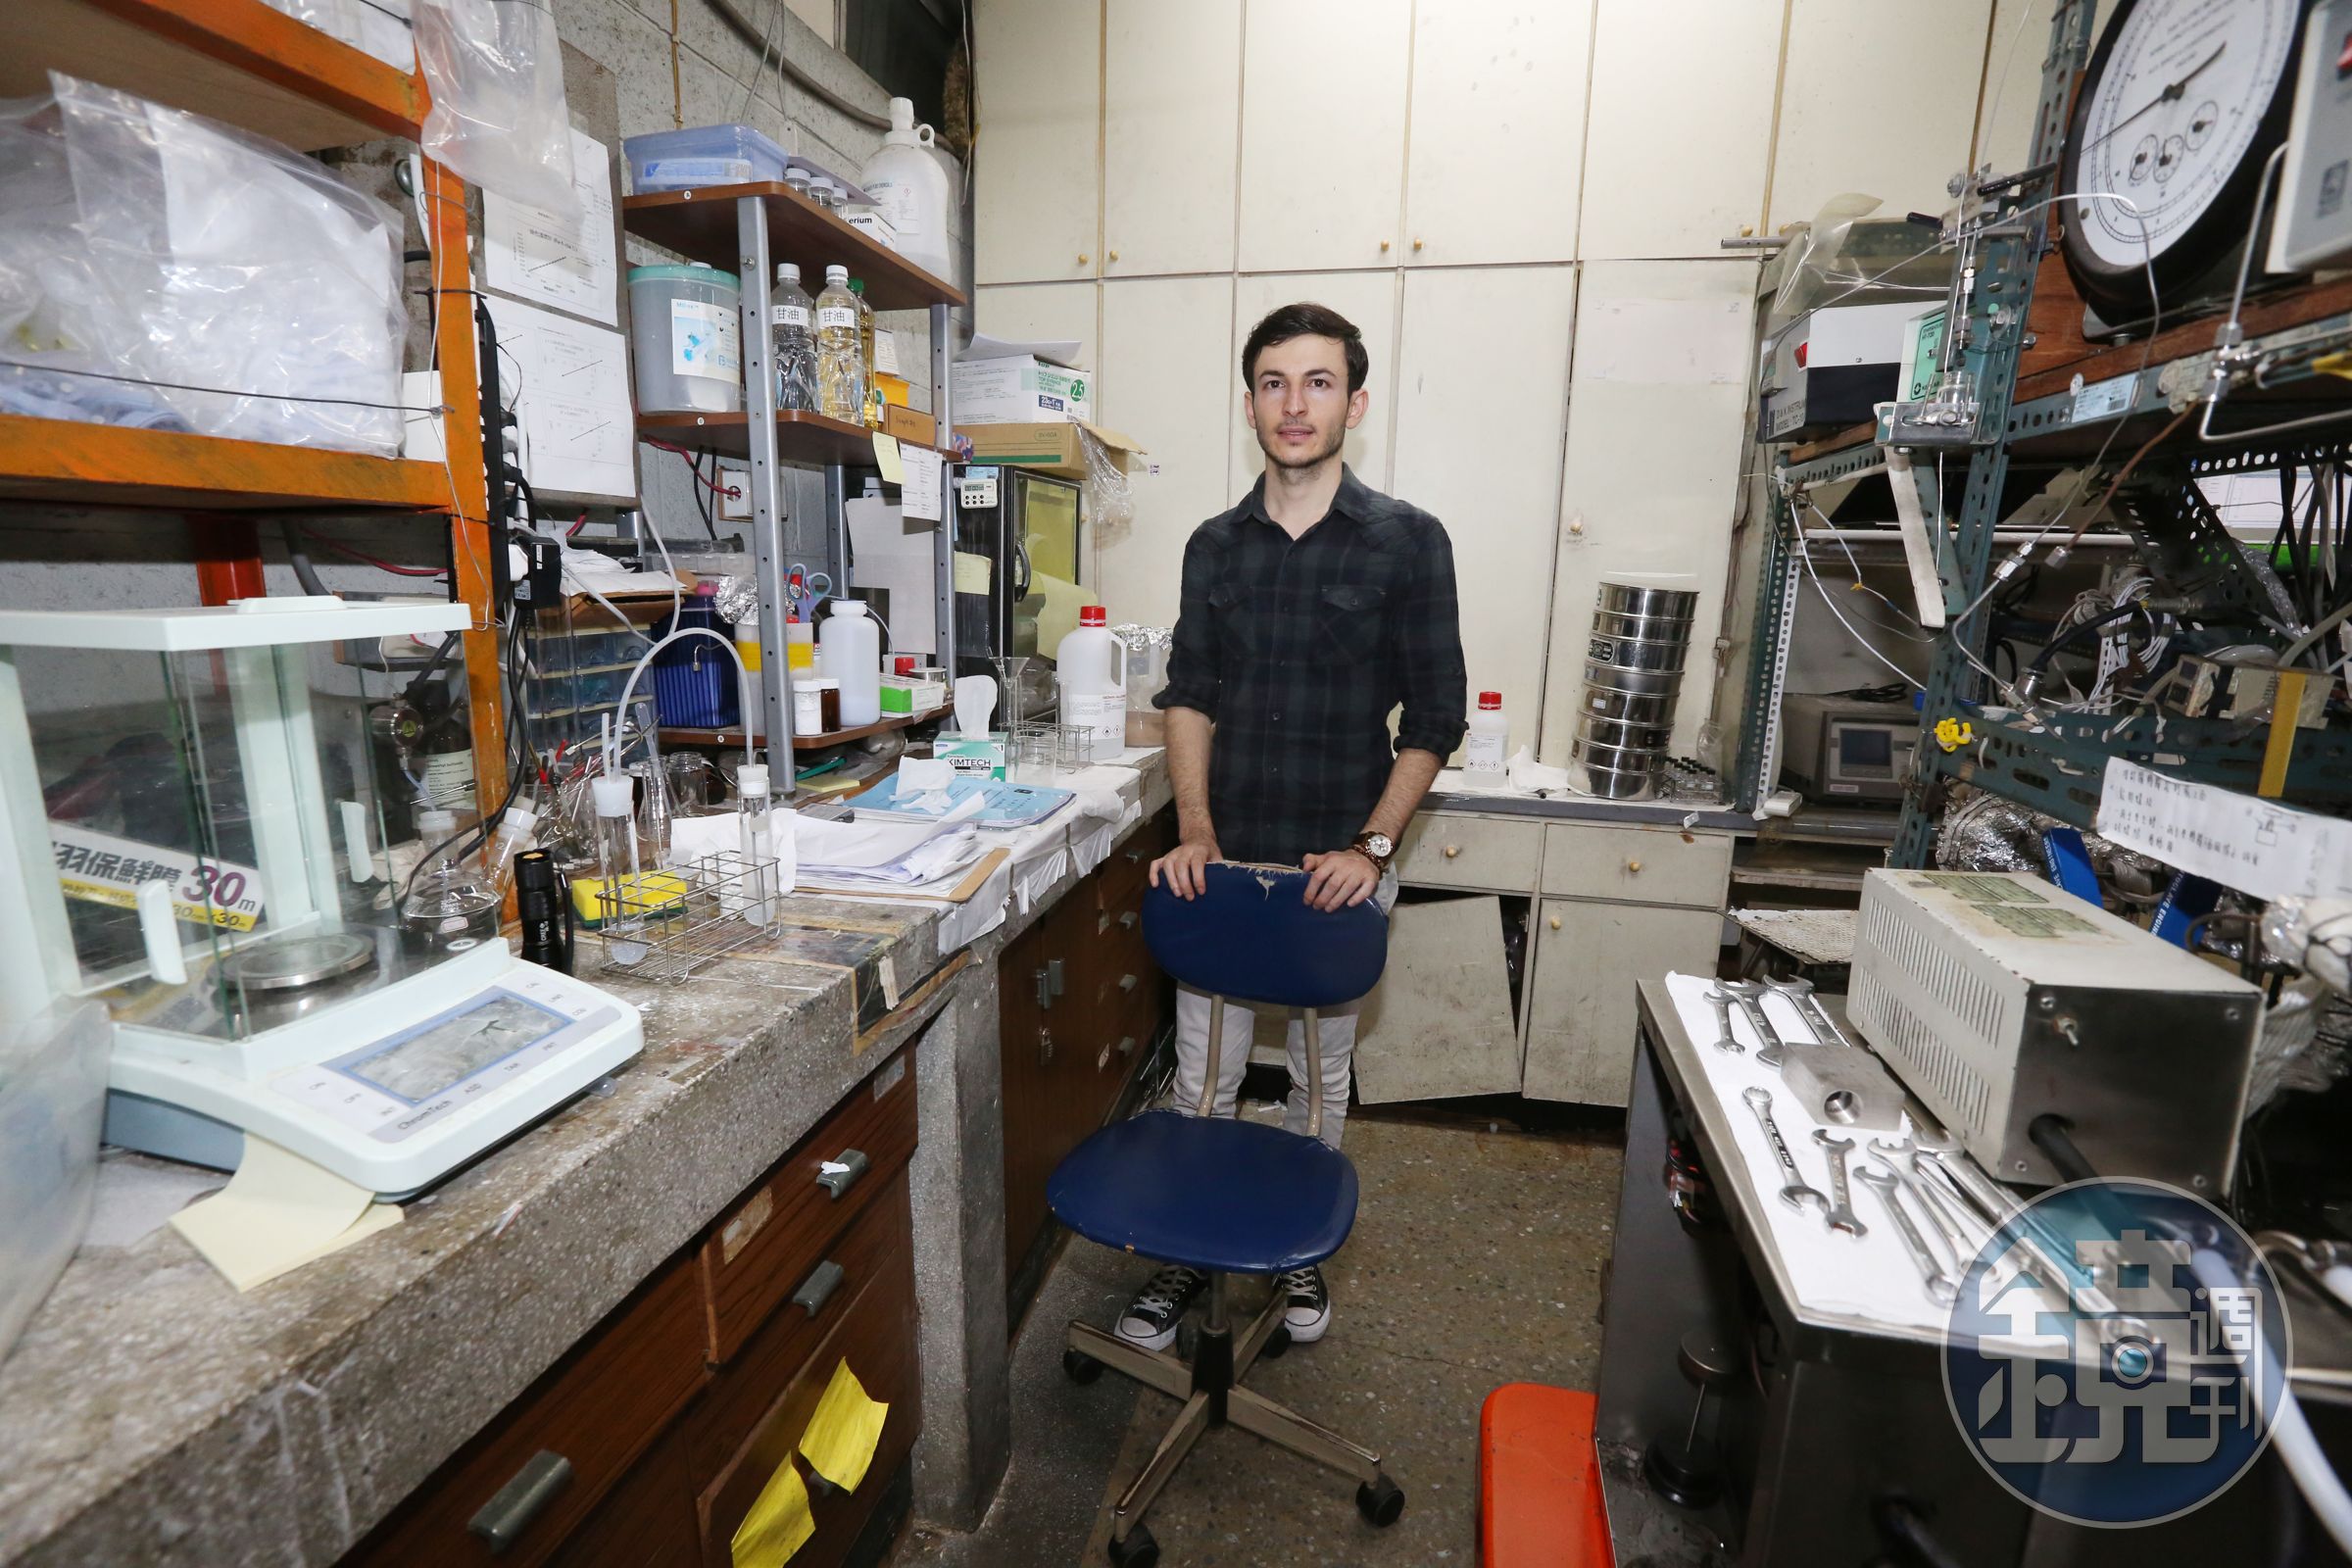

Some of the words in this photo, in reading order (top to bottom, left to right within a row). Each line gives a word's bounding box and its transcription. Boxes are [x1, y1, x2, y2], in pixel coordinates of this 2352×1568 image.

[776, 307, 799, 319] 甘油
[823, 310, 845, 321] 甘油
[398, 1100, 452, 1130] ChromTech
